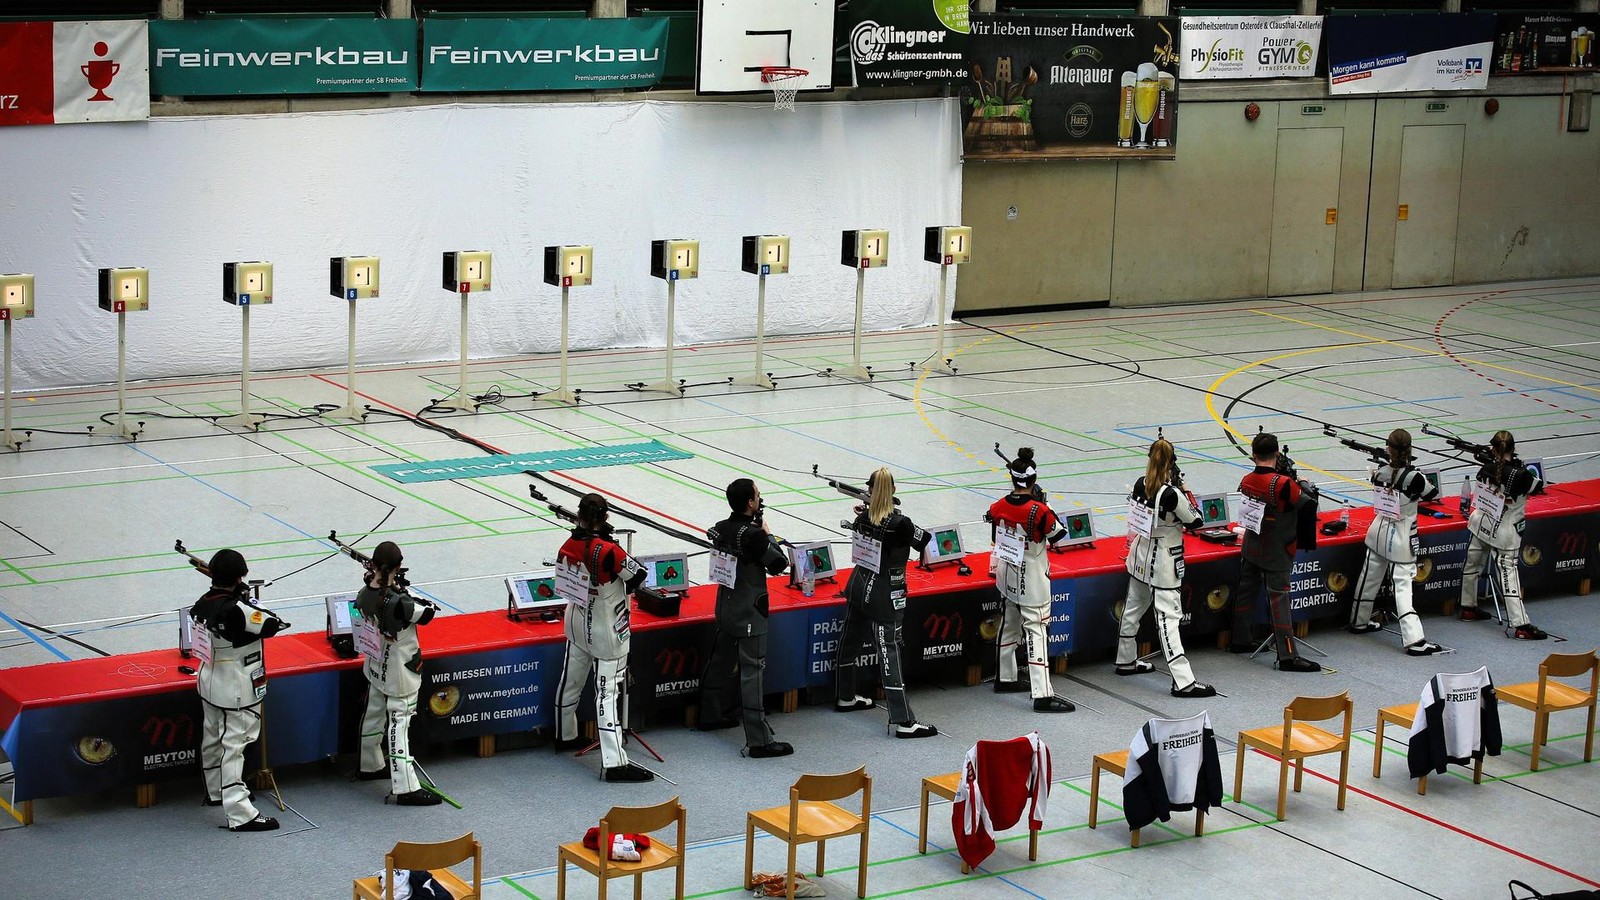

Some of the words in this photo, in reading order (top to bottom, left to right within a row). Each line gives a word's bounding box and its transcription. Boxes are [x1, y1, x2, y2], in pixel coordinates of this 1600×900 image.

[969, 22, 990, 35] Wir
[993, 22, 1031, 36] lieben
[1035, 24, 1069, 36] unser
[1070, 23, 1135, 38] Handwerk
[1182, 21, 1239, 31] Gesundheitszentrum
[1240, 21, 1263, 30] Osterode
[1263, 21, 1269, 29] &
[870, 25, 946, 48] Klingner
[1262, 36, 1296, 47] Power
[156, 46, 409, 67] Feinwerkbau
[429, 44, 659, 64] Feinwerkbau
[887, 50, 962, 61] Schützenzentrum
[1191, 46, 1244, 62] PhysioFit
[1257, 47, 1296, 65] GYM
[1332, 64, 1358, 75] Morgen
[1359, 61, 1375, 70] kann
[1376, 55, 1406, 66] kommen.
[574, 73, 619, 82] Premiumpartner
[865, 68, 968, 80] www.klingner-gmbh.de
[1049, 65, 1114, 87] Altenauer
[316, 77, 364, 85] Premiumpartner
[385, 76, 408, 84] Freiheit.
[863, 259, 869, 267] 11
[946, 256, 952, 264] 12
[462, 283, 467, 291] 7
[242, 295, 247, 304] 5
[349, 290, 355, 298] 6
[117, 302, 122, 311] 4
[1, 310, 7, 318] 3
[1428, 544, 1454, 554] MESSEN
[1455, 542, 1468, 550] MIT
[1290, 560, 1322, 575] ÄZISE.
[1555, 557, 1586, 569] MEYTON
[1289, 577, 1324, 593] EXIBEL.
[1424, 581, 1442, 591] MADE
[1443, 580, 1451, 588] IN
[981, 601, 998, 611] WIR
[1048, 613, 1070, 623] on.de
[813, 618, 844, 635] PRÄZ
[1048, 633, 1070, 643] MANY
[923, 642, 963, 656] MEYTON
[431, 672, 451, 684] WIR
[452, 667, 492, 681] MESSEN
[494, 664, 512, 676] MIT
[513, 661, 540, 673] LICHT
[655, 678, 700, 693] MEYTON
[467, 684, 539, 701] www.meyton.de
[450, 713, 479, 725] MADE
[480, 711, 491, 721] IN
[493, 705, 540, 720] GERMANY
[1162, 733, 1203, 751] FREIHEIT
[143, 749, 196, 765] MEYTON
